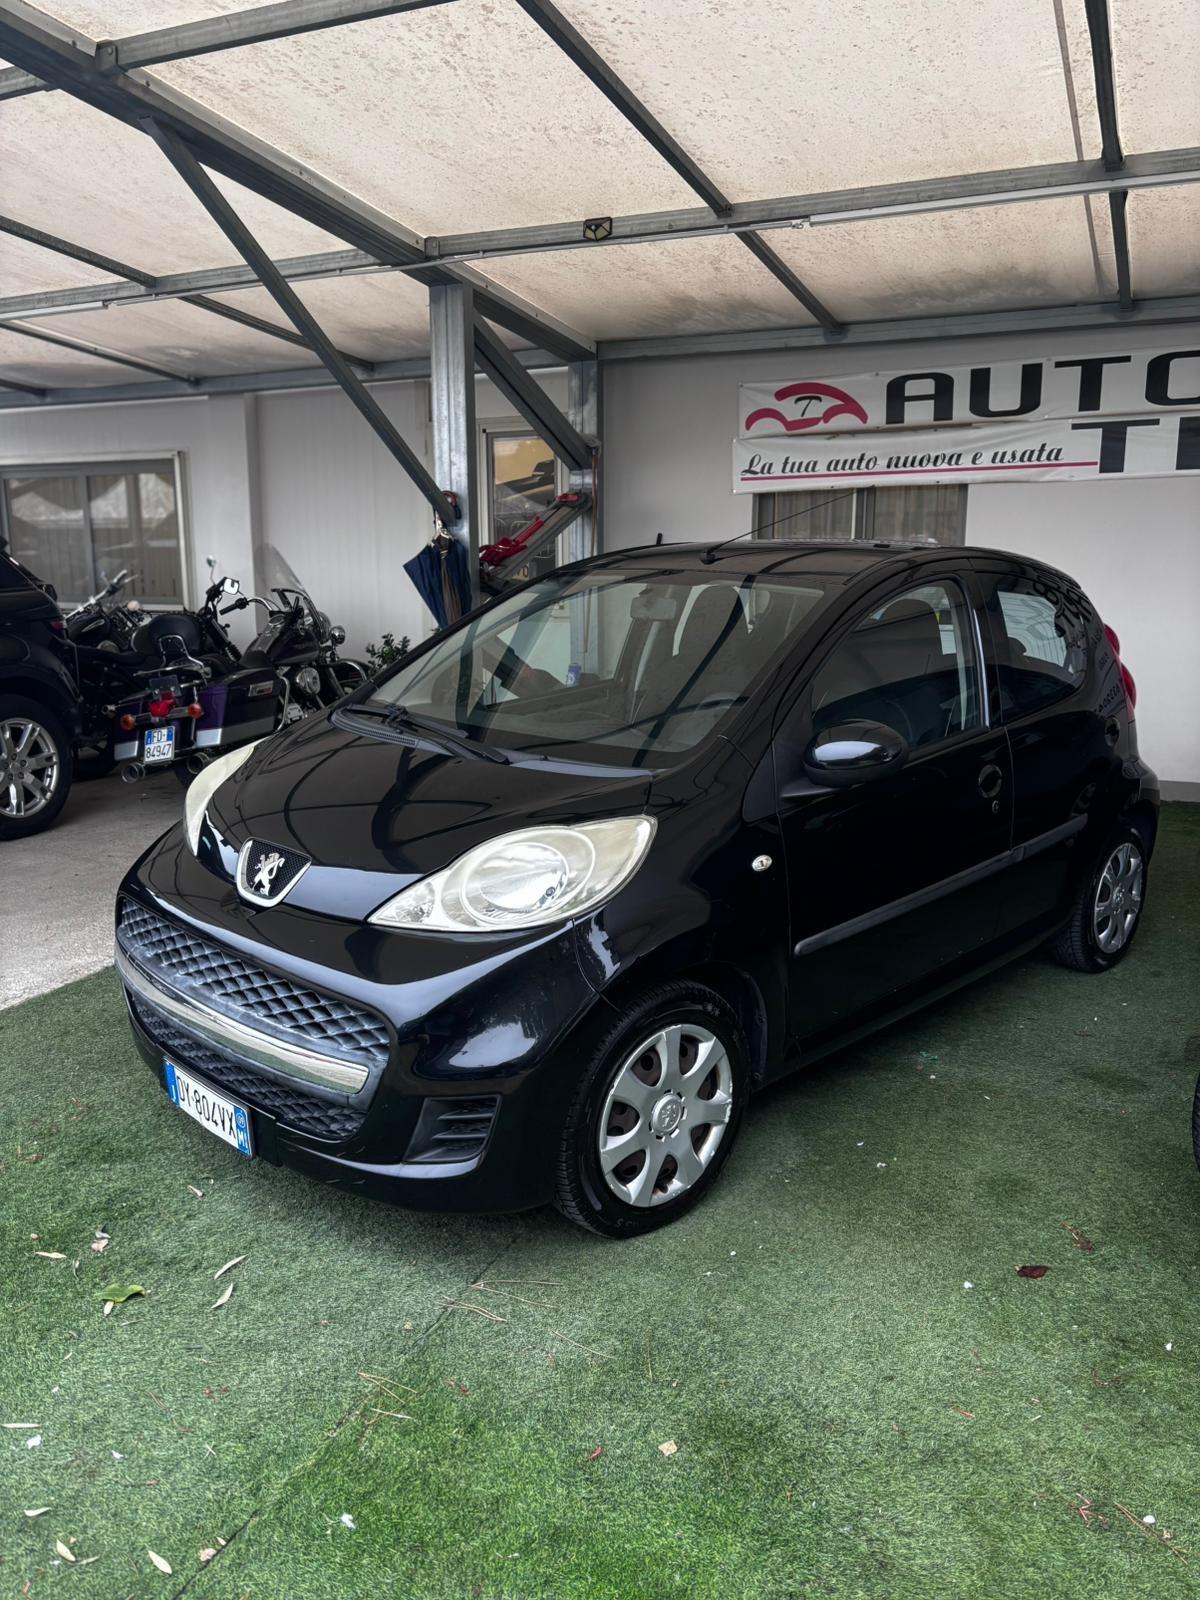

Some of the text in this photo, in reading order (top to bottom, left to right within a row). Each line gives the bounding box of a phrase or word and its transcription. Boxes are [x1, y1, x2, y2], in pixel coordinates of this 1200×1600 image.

[740, 442, 1064, 476] La tua auto nuova e usata
[146, 743, 171, 759] 84947
